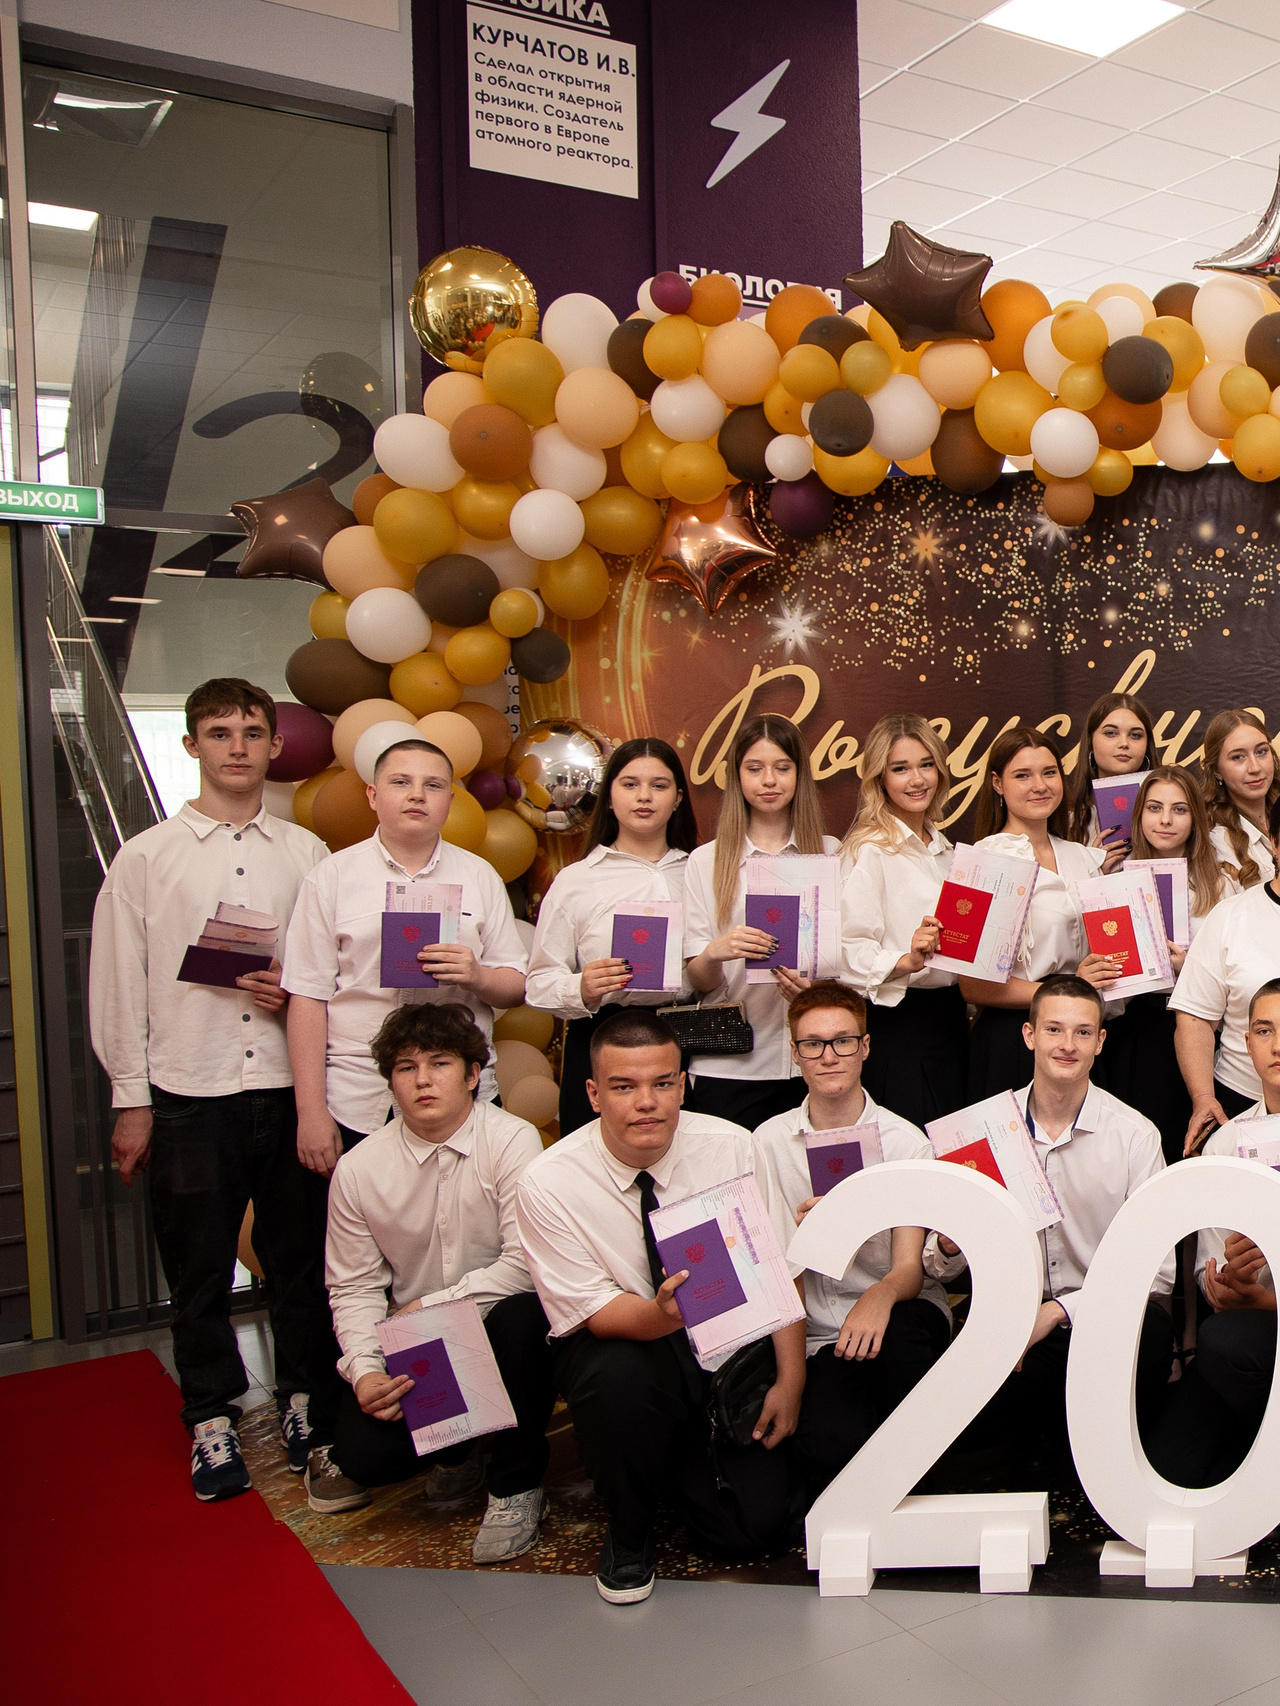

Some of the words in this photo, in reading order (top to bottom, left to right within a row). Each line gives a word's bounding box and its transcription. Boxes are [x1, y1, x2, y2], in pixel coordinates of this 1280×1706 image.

[498, 0, 610, 27] ИКА
[472, 22, 589, 66] КУРЧАТОВ
[597, 52, 636, 78] И.В.
[474, 51, 534, 76] Сделал
[538, 69, 611, 94] открытия
[475, 72, 483, 82] в
[487, 75, 554, 98] области
[558, 91, 623, 114] ядерной
[474, 89, 538, 114] физики.
[543, 104, 624, 132] Создатель
[475, 109, 540, 131] первого
[544, 124, 552, 134] в
[557, 125, 610, 146] Европе
[475, 127, 552, 152] атомного
[556, 143, 634, 169] реактора.
[679, 264, 842, 311] БЛОЯ
